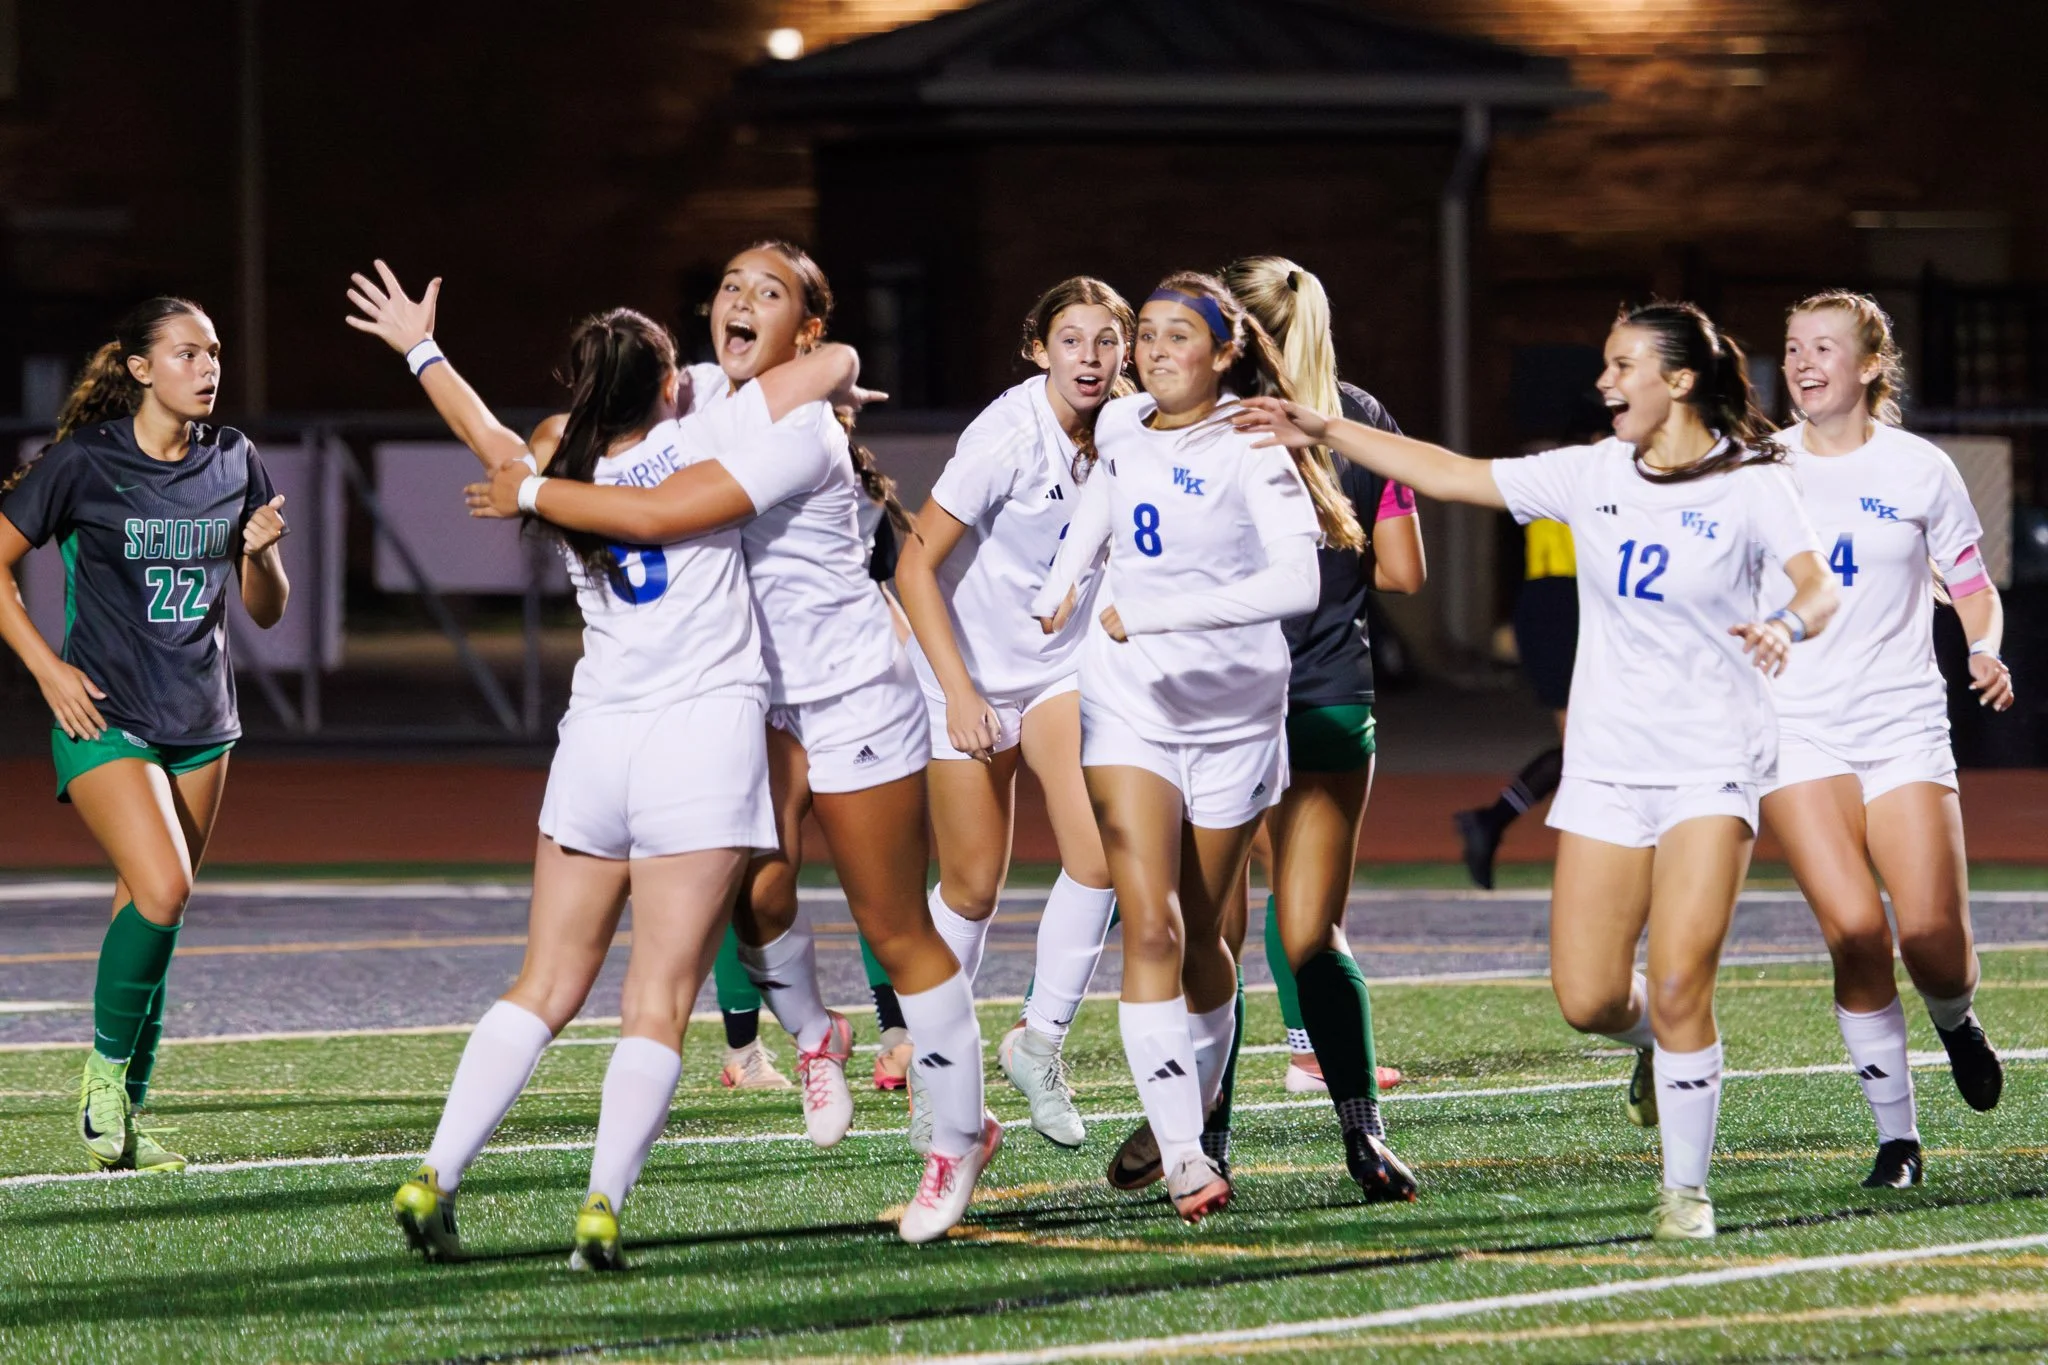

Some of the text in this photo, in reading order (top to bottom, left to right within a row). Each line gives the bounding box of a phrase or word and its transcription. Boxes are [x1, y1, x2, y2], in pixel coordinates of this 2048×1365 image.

[1173, 467, 1206, 496] WK
[1859, 497, 1899, 520] WK
[124, 518, 230, 560] SCIOTO
[1133, 502, 1163, 557] 8
[1618, 539, 1670, 602] 12
[1829, 532, 1859, 587] 4
[145, 566, 210, 622] 22
